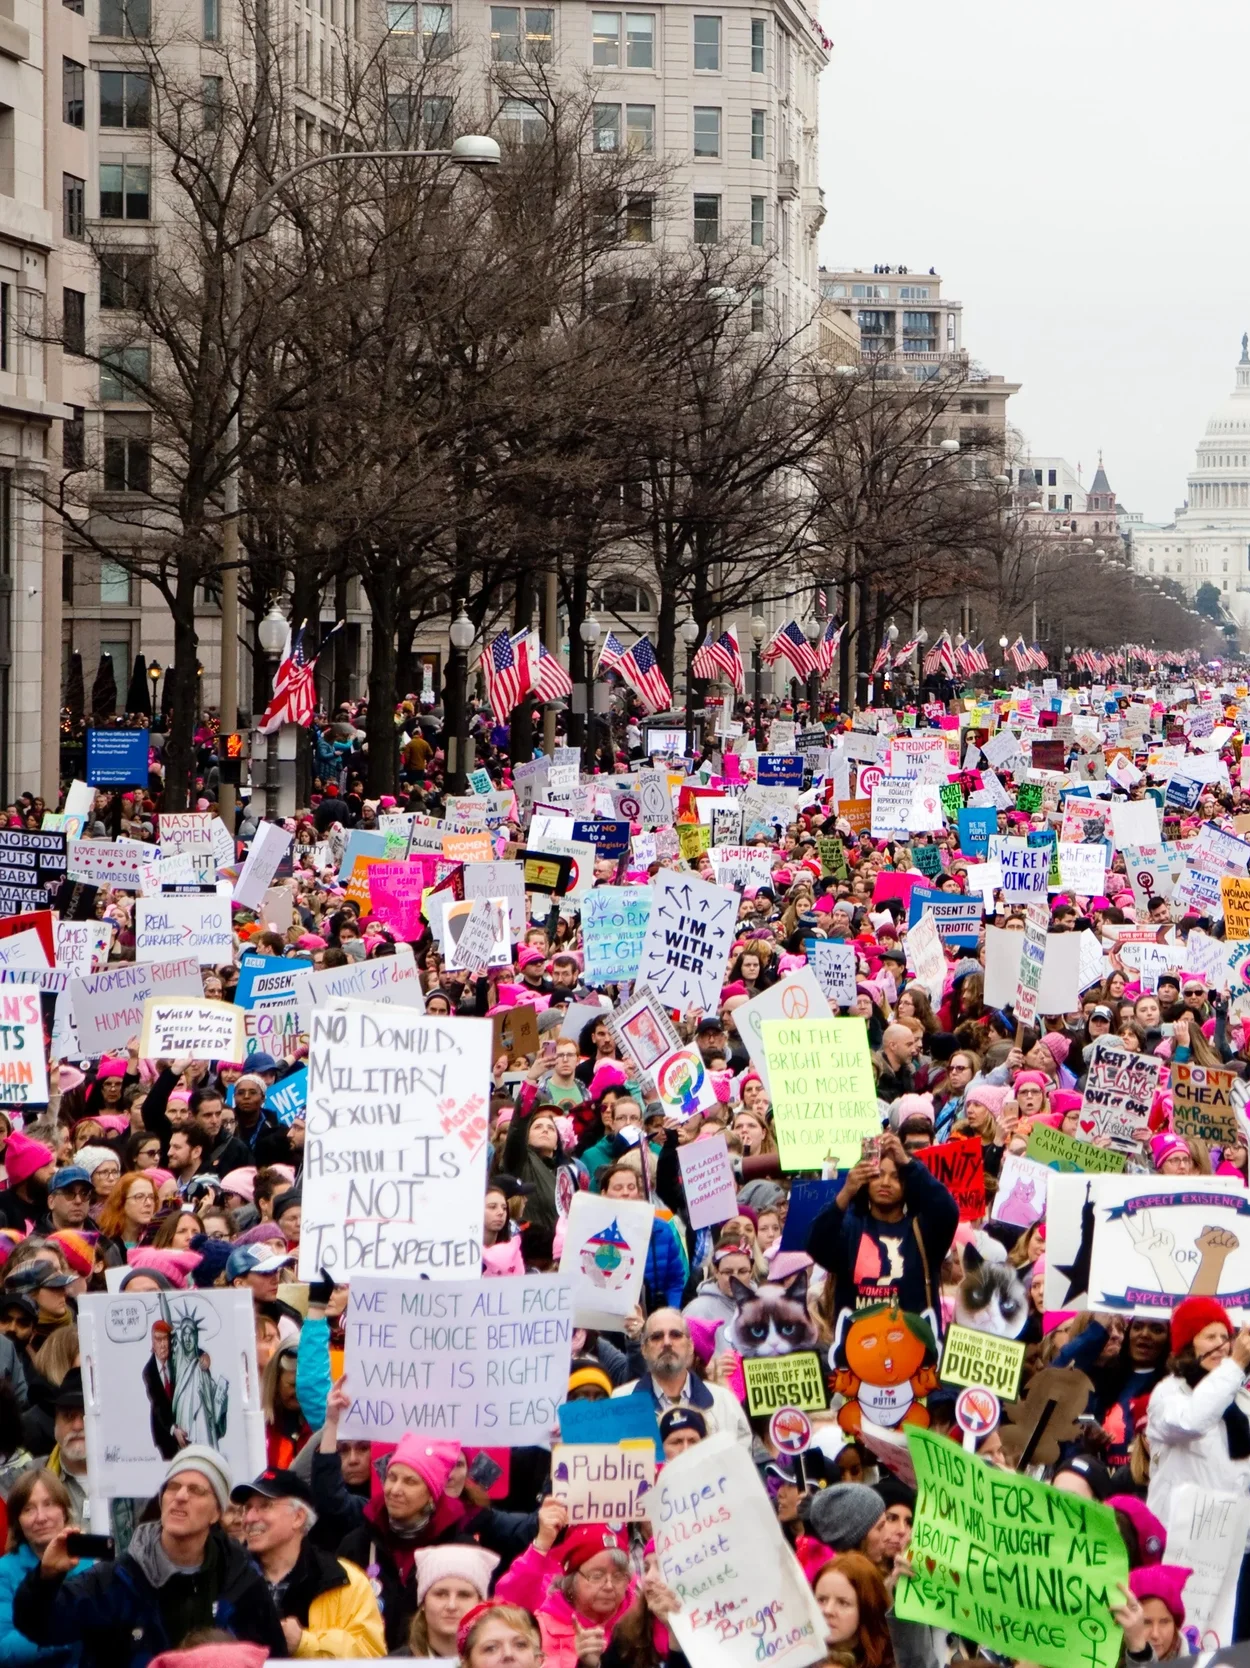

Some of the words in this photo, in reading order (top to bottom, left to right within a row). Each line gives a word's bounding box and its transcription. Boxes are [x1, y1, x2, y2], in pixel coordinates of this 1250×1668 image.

[893, 740, 943, 752] STRONGER
[161, 815, 208, 829] NASTY
[581, 823, 598, 833] SAY
[600, 824, 616, 833] NO
[0, 833, 62, 849] NOBODY
[163, 829, 211, 844] WOMEN
[0, 888, 48, 903] MAKER
[144, 914, 174, 930] REAL
[200, 915, 222, 929] 140
[679, 915, 706, 938] I'M
[137, 933, 183, 947] CHARACTER
[188, 932, 232, 946] CHARACTERS
[664, 930, 714, 959] WITH
[245, 957, 265, 968] ACLU
[666, 949, 704, 975] HER
[824, 970, 847, 980] WITH
[82, 968, 146, 995] WOMEN'S
[151, 959, 199, 982] RIGHTS
[826, 979, 845, 987] HER
[133, 988, 152, 1001] ARE
[778, 1030, 801, 1045] ON
[809, 1029, 843, 1044] THE
[310, 1052, 446, 1096] MILITARY
[768, 1052, 822, 1070] BRIGHT
[831, 1052, 864, 1069] SIDE
[1096, 1046, 1125, 1065] KEEP
[1128, 1054, 1158, 1075] YOUR
[784, 1077, 807, 1094] NO
[816, 1076, 860, 1094] MORE
[1097, 1065, 1156, 1099] LAWS
[308, 1099, 421, 1135] SEXUAL
[777, 1103, 834, 1121] GRIZZLY
[838, 1100, 877, 1120] BEARS
[781, 1130, 796, 1145] IN
[800, 1129, 827, 1145] OUR
[1035, 1136, 1079, 1163] CANNOT
[1043, 1127, 1065, 1142] OUR
[1070, 1139, 1123, 1166] CLIMATE
[307, 1139, 405, 1179] ASSAULT
[414, 1136, 461, 1179] IS
[347, 1180, 423, 1220] NOT
[1127, 1194, 1175, 1211] RESPECT
[1181, 1193, 1244, 1209] EXISTENCE
[1175, 1248, 1198, 1264] OR
[351, 1292, 388, 1313] WE
[401, 1293, 463, 1318] MUST
[470, 1292, 510, 1316] ALL
[521, 1287, 571, 1314] FACE
[353, 1323, 397, 1349] THE
[409, 1326, 478, 1351] CHOICE
[487, 1319, 570, 1350] BETWEEN
[361, 1359, 436, 1389] WHAT
[451, 1361, 475, 1389] IS
[486, 1354, 556, 1387] RIGHT
[945, 1354, 1016, 1392] PUSSY!
[752, 1380, 822, 1409] PUSSY!
[873, 1396, 897, 1406] PUTIN
[344, 1399, 394, 1426] AND
[401, 1404, 461, 1429] WHAT
[475, 1404, 499, 1427] IS
[509, 1398, 563, 1425] EASY
[573, 1454, 645, 1481] Public
[919, 1436, 965, 1487] THIS
[971, 1461, 984, 1503] IS
[991, 1480, 1042, 1524] FOR
[1047, 1490, 1086, 1533] MY
[659, 1476, 727, 1523] Super
[655, 1507, 732, 1557] Callous
[921, 1479, 959, 1528] MOM
[961, 1505, 985, 1542] WHO
[987, 1521, 1054, 1558] TAUGHT
[1068, 1535, 1107, 1567] ME
[662, 1533, 731, 1582] Fascist
[914, 1520, 960, 1563] ABOUT
[966, 1544, 1108, 1617] FEMINISM
[677, 1564, 738, 1604] Racist
[905, 1576, 959, 1611] REST
[974, 1603, 994, 1634] IN
[1001, 1615, 1066, 1649] PEACE
